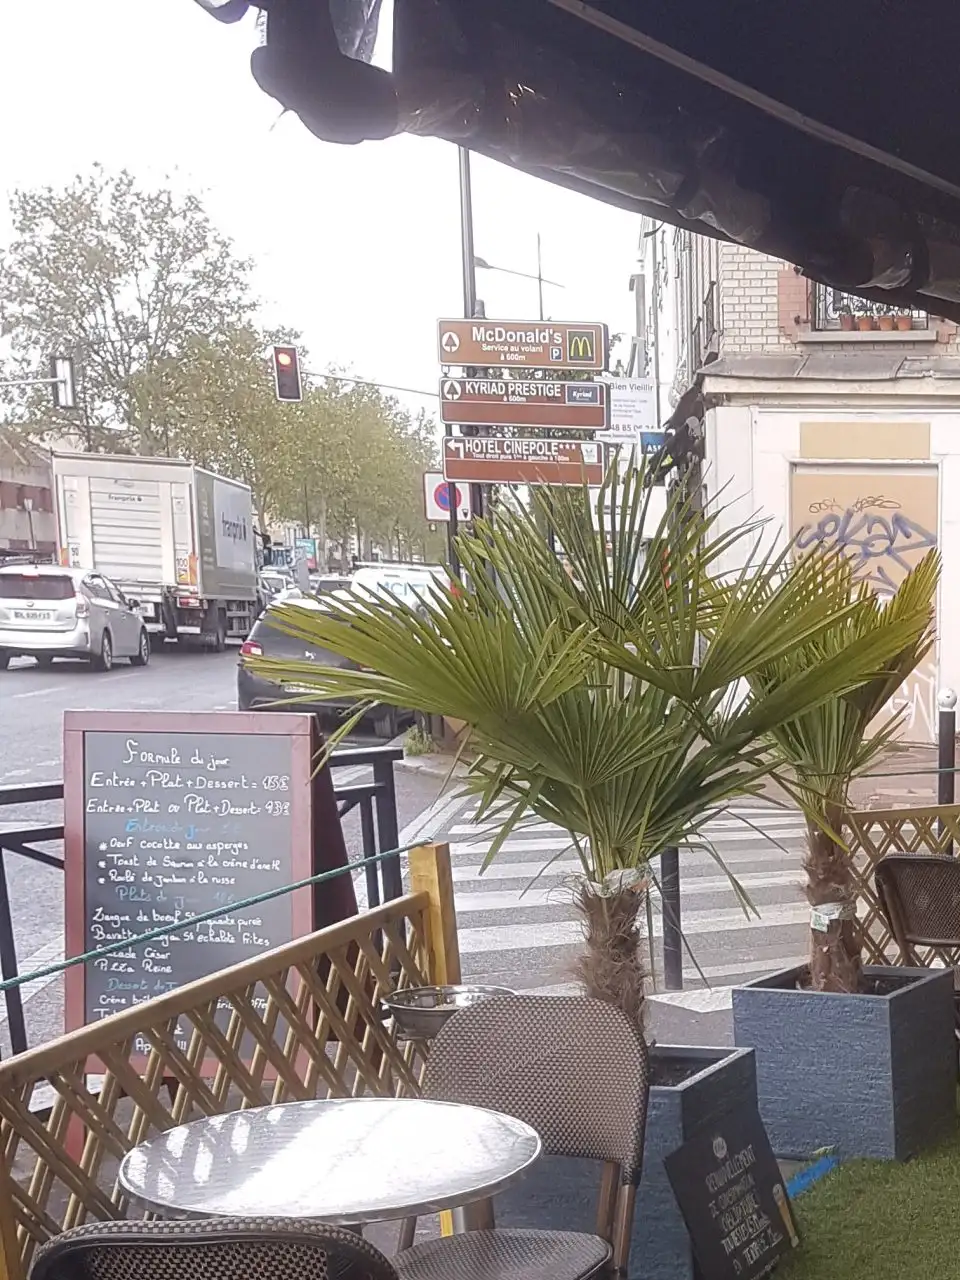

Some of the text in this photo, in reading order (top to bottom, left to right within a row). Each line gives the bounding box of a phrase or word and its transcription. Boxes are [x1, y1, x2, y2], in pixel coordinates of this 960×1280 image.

[472, 326, 562, 344] McDonald's
[481, 343, 508, 352] Service
[465, 382, 561, 397] KYRIAD PRESTIGE
[465, 439, 559, 456] HOTEL CINEPOLE
[206, 753, 230, 771] jour
[91, 771, 136, 788] Entrée
[146, 770, 184, 788] Plat
[194, 775, 250, 789] Dessert
[140, 837, 181, 850] cocotte
[186, 842, 203, 850] aux
[206, 841, 249, 856] asperges
[106, 853, 140, 867] Toast
[146, 855, 158, 866] de
[208, 854, 219, 867] la
[249, 858, 281, 872] d'aneth
[142, 870, 153, 883] de
[198, 870, 209, 884] la
[211, 875, 236, 885] russe
[93, 907, 131, 928] Langue
[136, 909, 149, 922] de
[91, 924, 137, 941] Bavette
[142, 958, 173, 973] Reine
